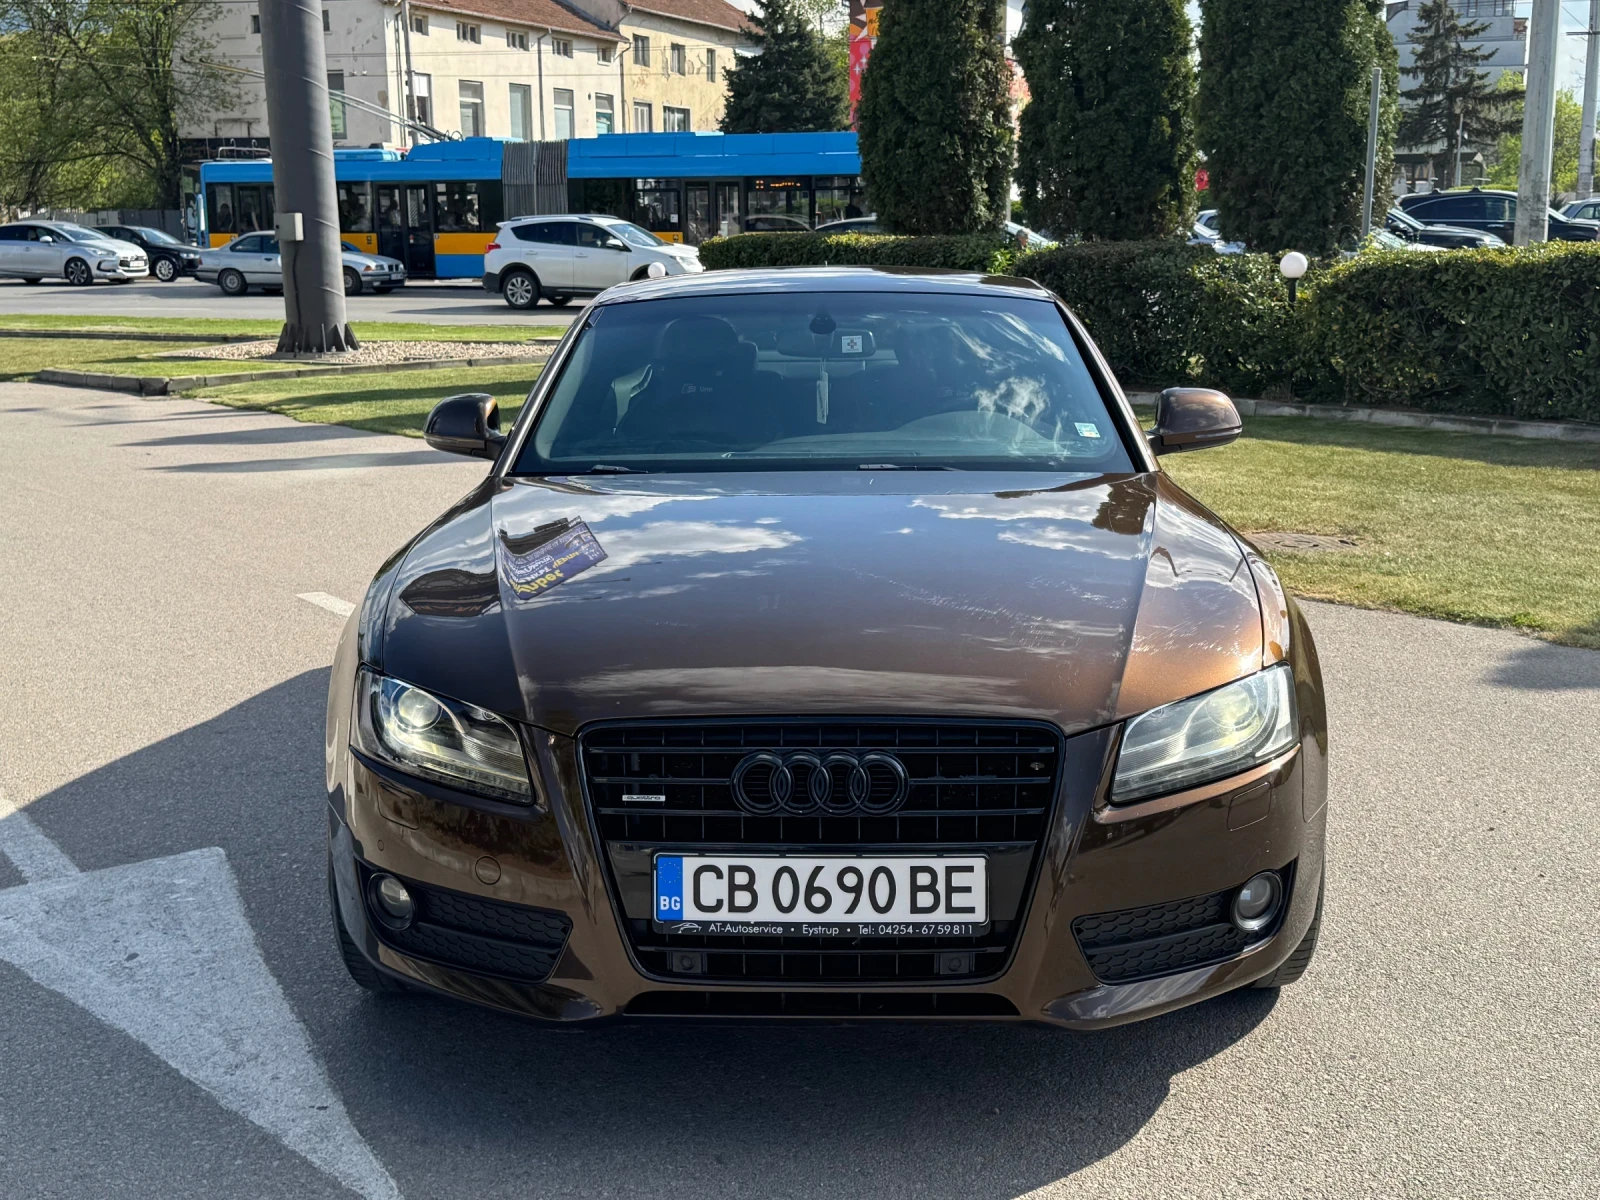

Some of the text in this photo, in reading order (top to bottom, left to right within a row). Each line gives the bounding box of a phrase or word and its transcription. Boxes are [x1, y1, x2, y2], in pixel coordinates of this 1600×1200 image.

[692, 864, 976, 915] CB 0690 BE
[659, 895, 681, 911] BG
[708, 923, 784, 935] AT-Autoservice
[802, 924, 840, 937] Eystrup
[858, 924, 875, 935] Tel:
